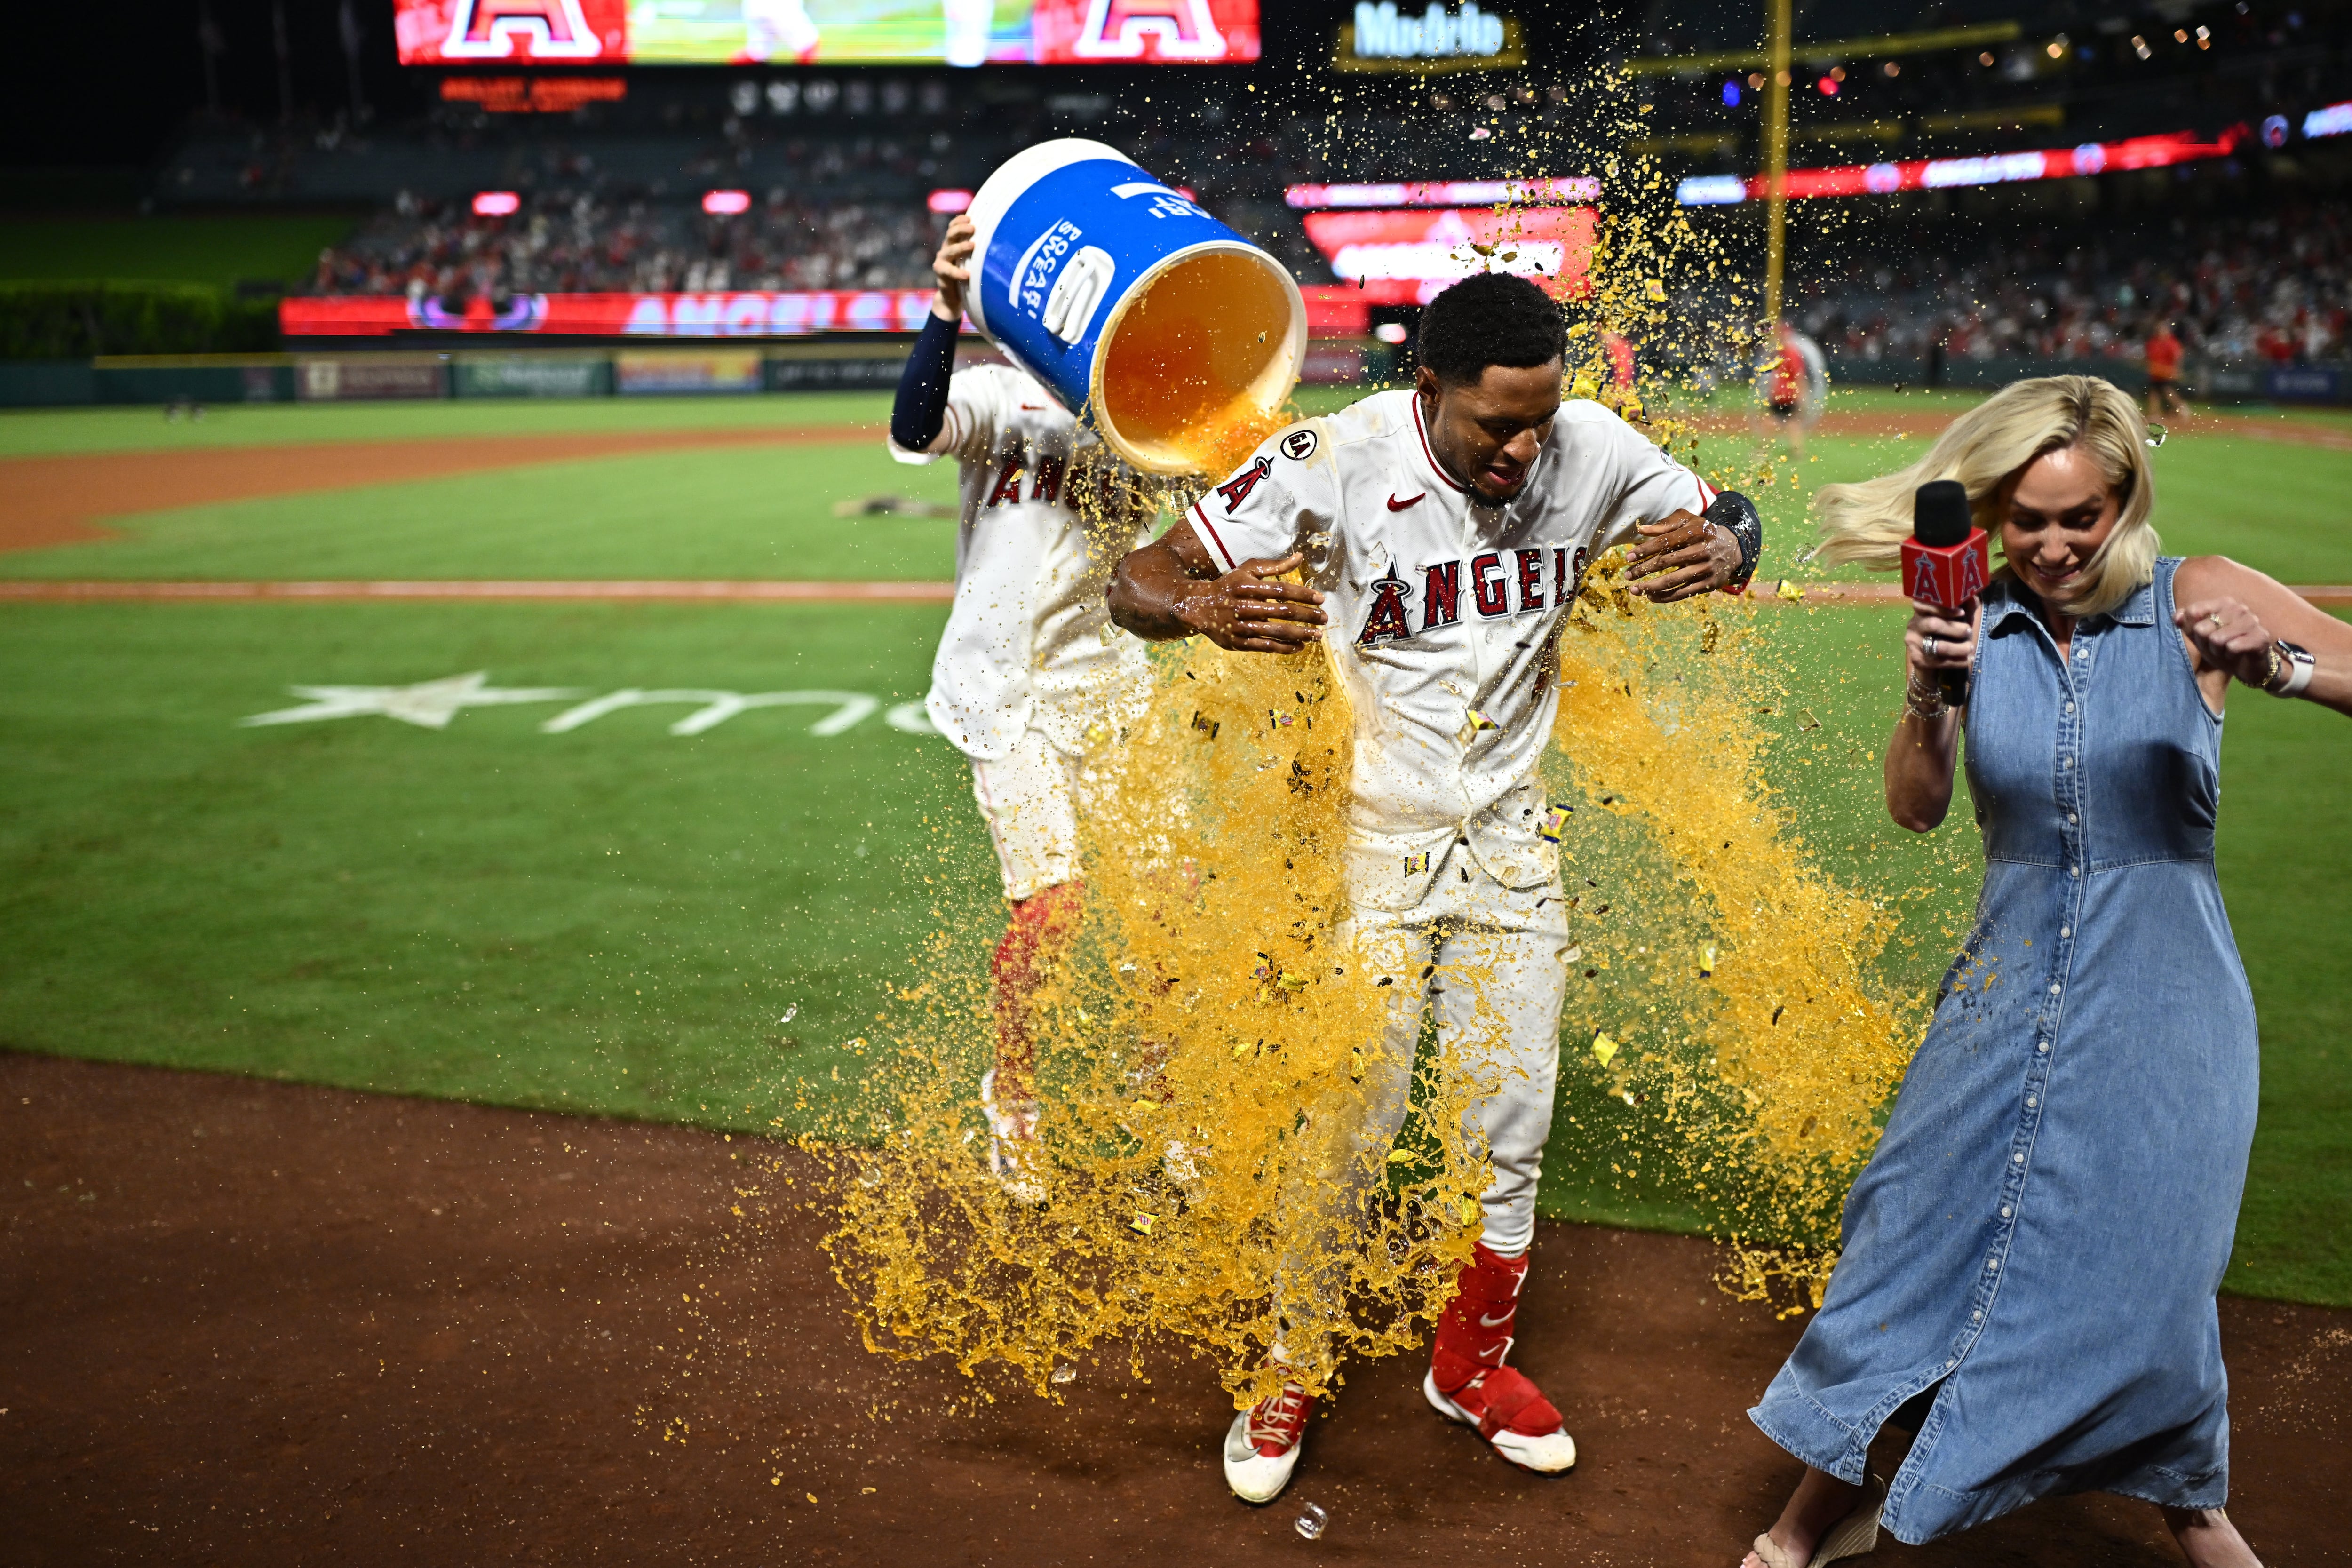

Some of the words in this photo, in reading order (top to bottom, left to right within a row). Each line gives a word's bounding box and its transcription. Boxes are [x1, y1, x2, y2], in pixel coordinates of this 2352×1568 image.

[1022, 220, 1074, 305] SWEAT
[1027, 226, 1083, 320] POCARI
[1288, 432, 1311, 457] GA
[1216, 456, 1275, 515] A
[1913, 551, 1942, 603] A
[1959, 545, 1984, 601] A
